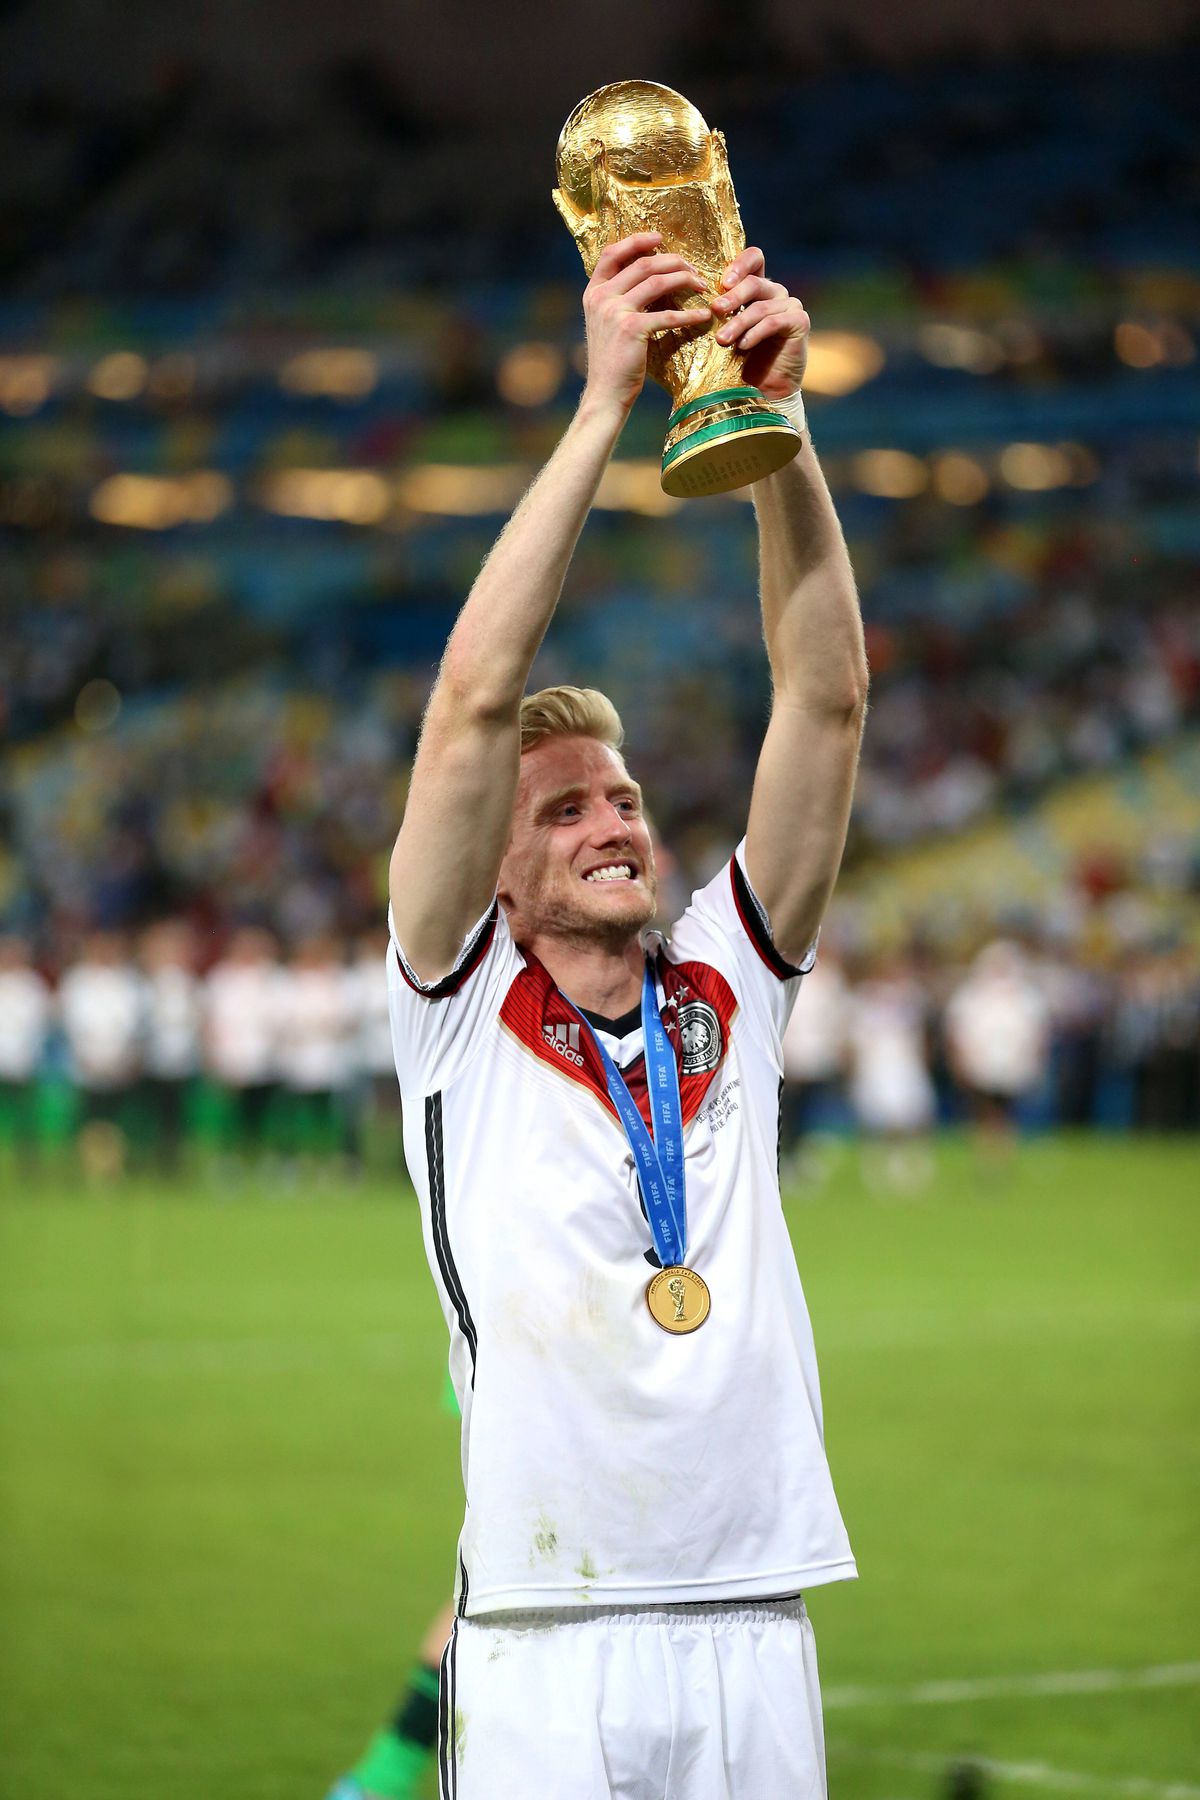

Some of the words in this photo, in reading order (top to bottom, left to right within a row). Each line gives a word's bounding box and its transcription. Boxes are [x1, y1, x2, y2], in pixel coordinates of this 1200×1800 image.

[659, 1066, 668, 1088] FIFA
[662, 1102, 672, 1124] FIFA
[640, 1144, 652, 1167] FIFA
[666, 1139, 674, 1162] FIFA
[649, 1182, 661, 1205] FIFA
[660, 1220, 672, 1243] FIFA
